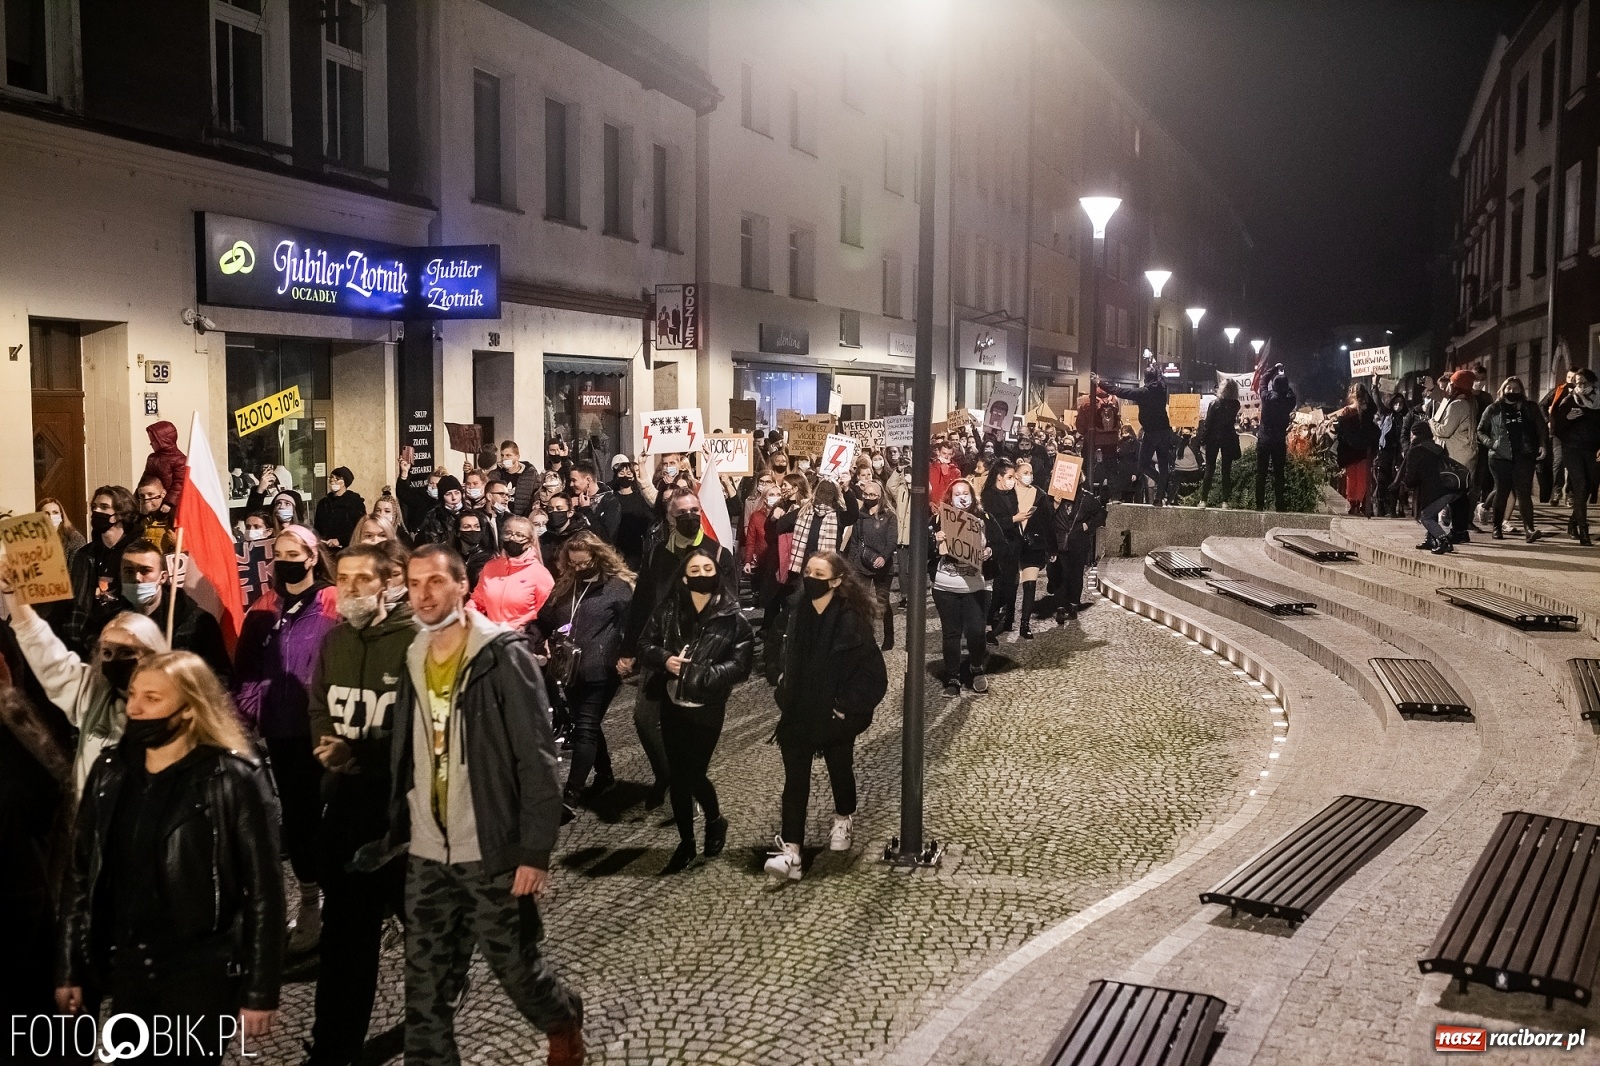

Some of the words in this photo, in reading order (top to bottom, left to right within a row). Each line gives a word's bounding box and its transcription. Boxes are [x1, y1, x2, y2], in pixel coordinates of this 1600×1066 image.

[273, 240, 344, 295] Jubiler
[346, 250, 409, 298] Złotnik
[427, 258, 482, 286] Jubiler
[291, 286, 338, 303] OCZADŁY
[428, 287, 484, 311] Złotnik
[153, 365, 169, 378] 36
[147, 400, 157, 410] 36
[583, 395, 611, 406] PRZECENA
[237, 402, 273, 432] ZŁOTO
[275, 391, 299, 414] -10%
[409, 423, 432, 433] SPRZEDAŻ
[944, 509, 956, 522] TO
